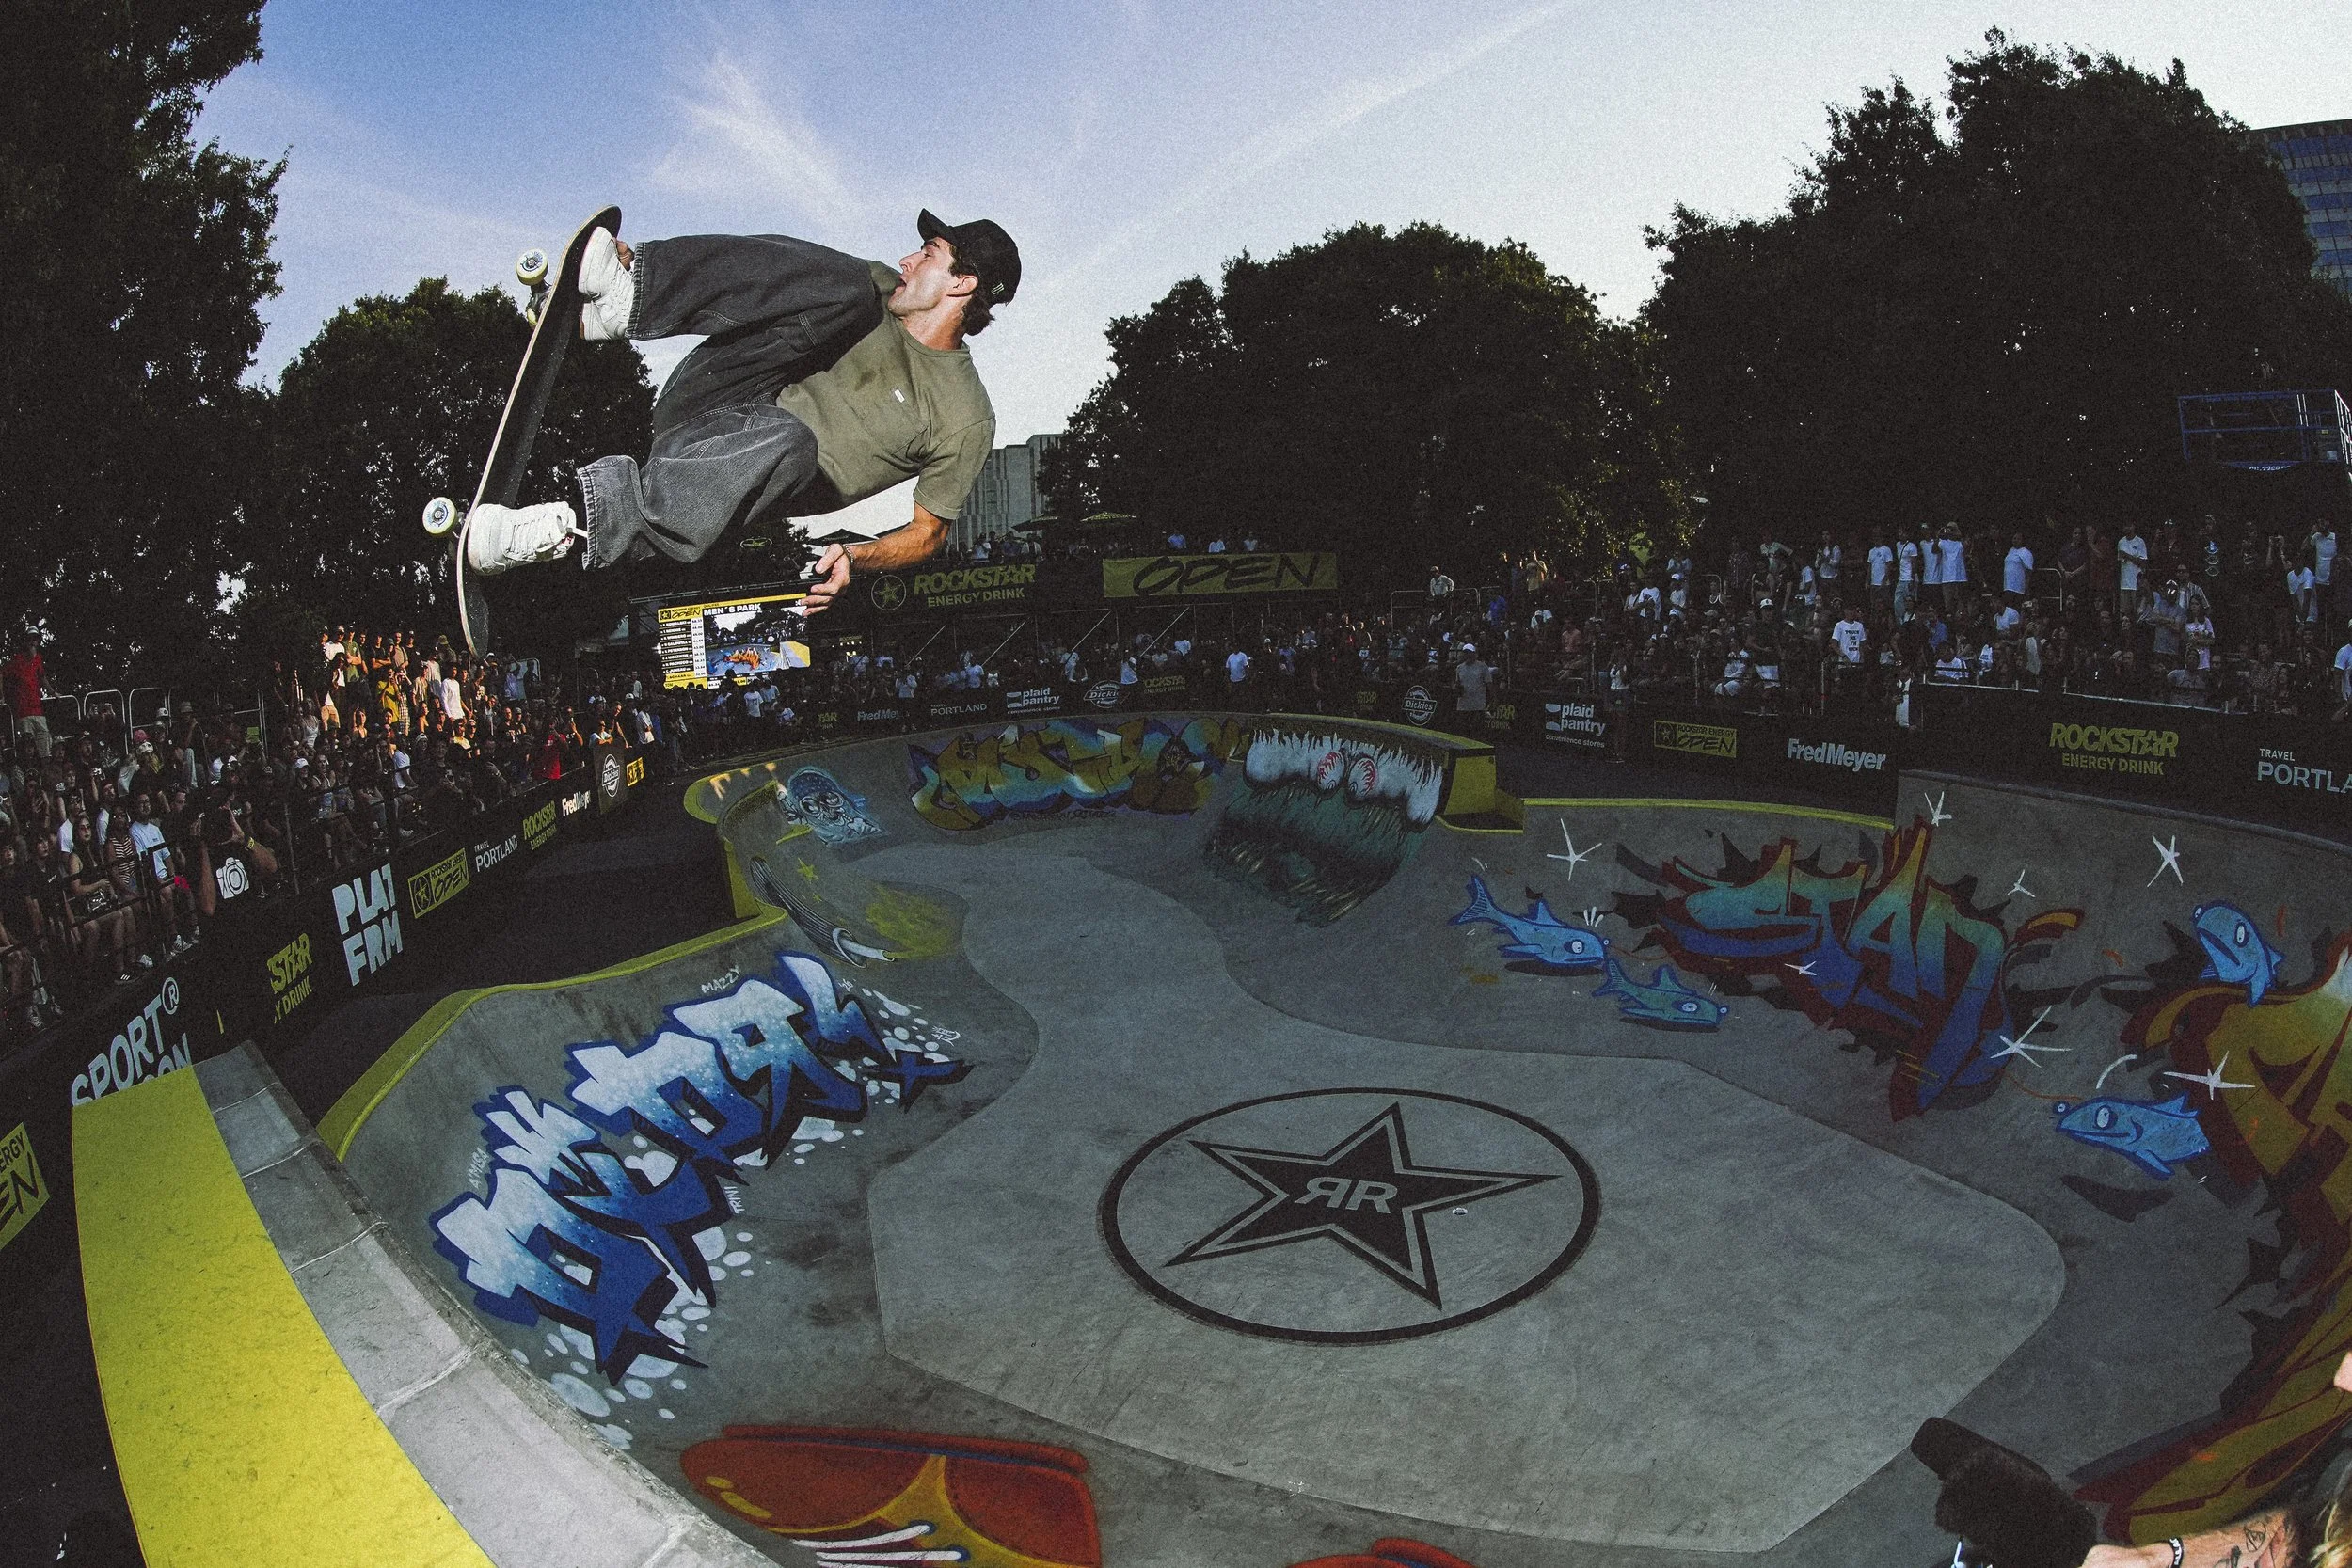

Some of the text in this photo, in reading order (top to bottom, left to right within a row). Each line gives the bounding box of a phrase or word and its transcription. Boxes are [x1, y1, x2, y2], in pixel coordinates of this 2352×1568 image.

[914, 563, 1035, 595] ROCKSTAR
[1132, 556, 1319, 597] OPEN
[928, 588, 1025, 608] ENERGY DRINK
[672, 610, 701, 619] OPEN
[737, 603, 762, 612] PARK
[1144, 675, 1185, 688] OCKSTA
[1023, 687, 1050, 699] plaid
[1023, 695, 1060, 706] pantry
[1089, 689, 1119, 699] Dicki
[857, 708, 900, 721] FredMe
[930, 703, 987, 717] PORTLAND
[1405, 700, 1433, 711] Dickies
[1562, 702, 1594, 719] plaid
[1561, 717, 1606, 736] pantry
[1677, 723, 1736, 738] ROCKSTAR ENERGY
[1545, 734, 1605, 749] convenience stores
[1677, 735, 1736, 753] OPEN
[2049, 722, 2178, 757] ROCKSTAR
[1787, 738, 1886, 771] FredMeyer
[2259, 748, 2296, 762] TRAVEL
[2062, 752, 2164, 776] ENERGY DRINK
[522, 800, 557, 840] ROCKSTAR
[474, 840, 489, 852] TRAVEL
[475, 834, 517, 872] PORTLAND
[435, 864, 468, 903] OPEN
[342, 910, 403, 986] FRM
[267, 933, 313, 994] STAR
[701, 964, 740, 993] MAZZY
[283, 975, 313, 1016] DRINK
[723, 1186, 745, 1213] TRINI
